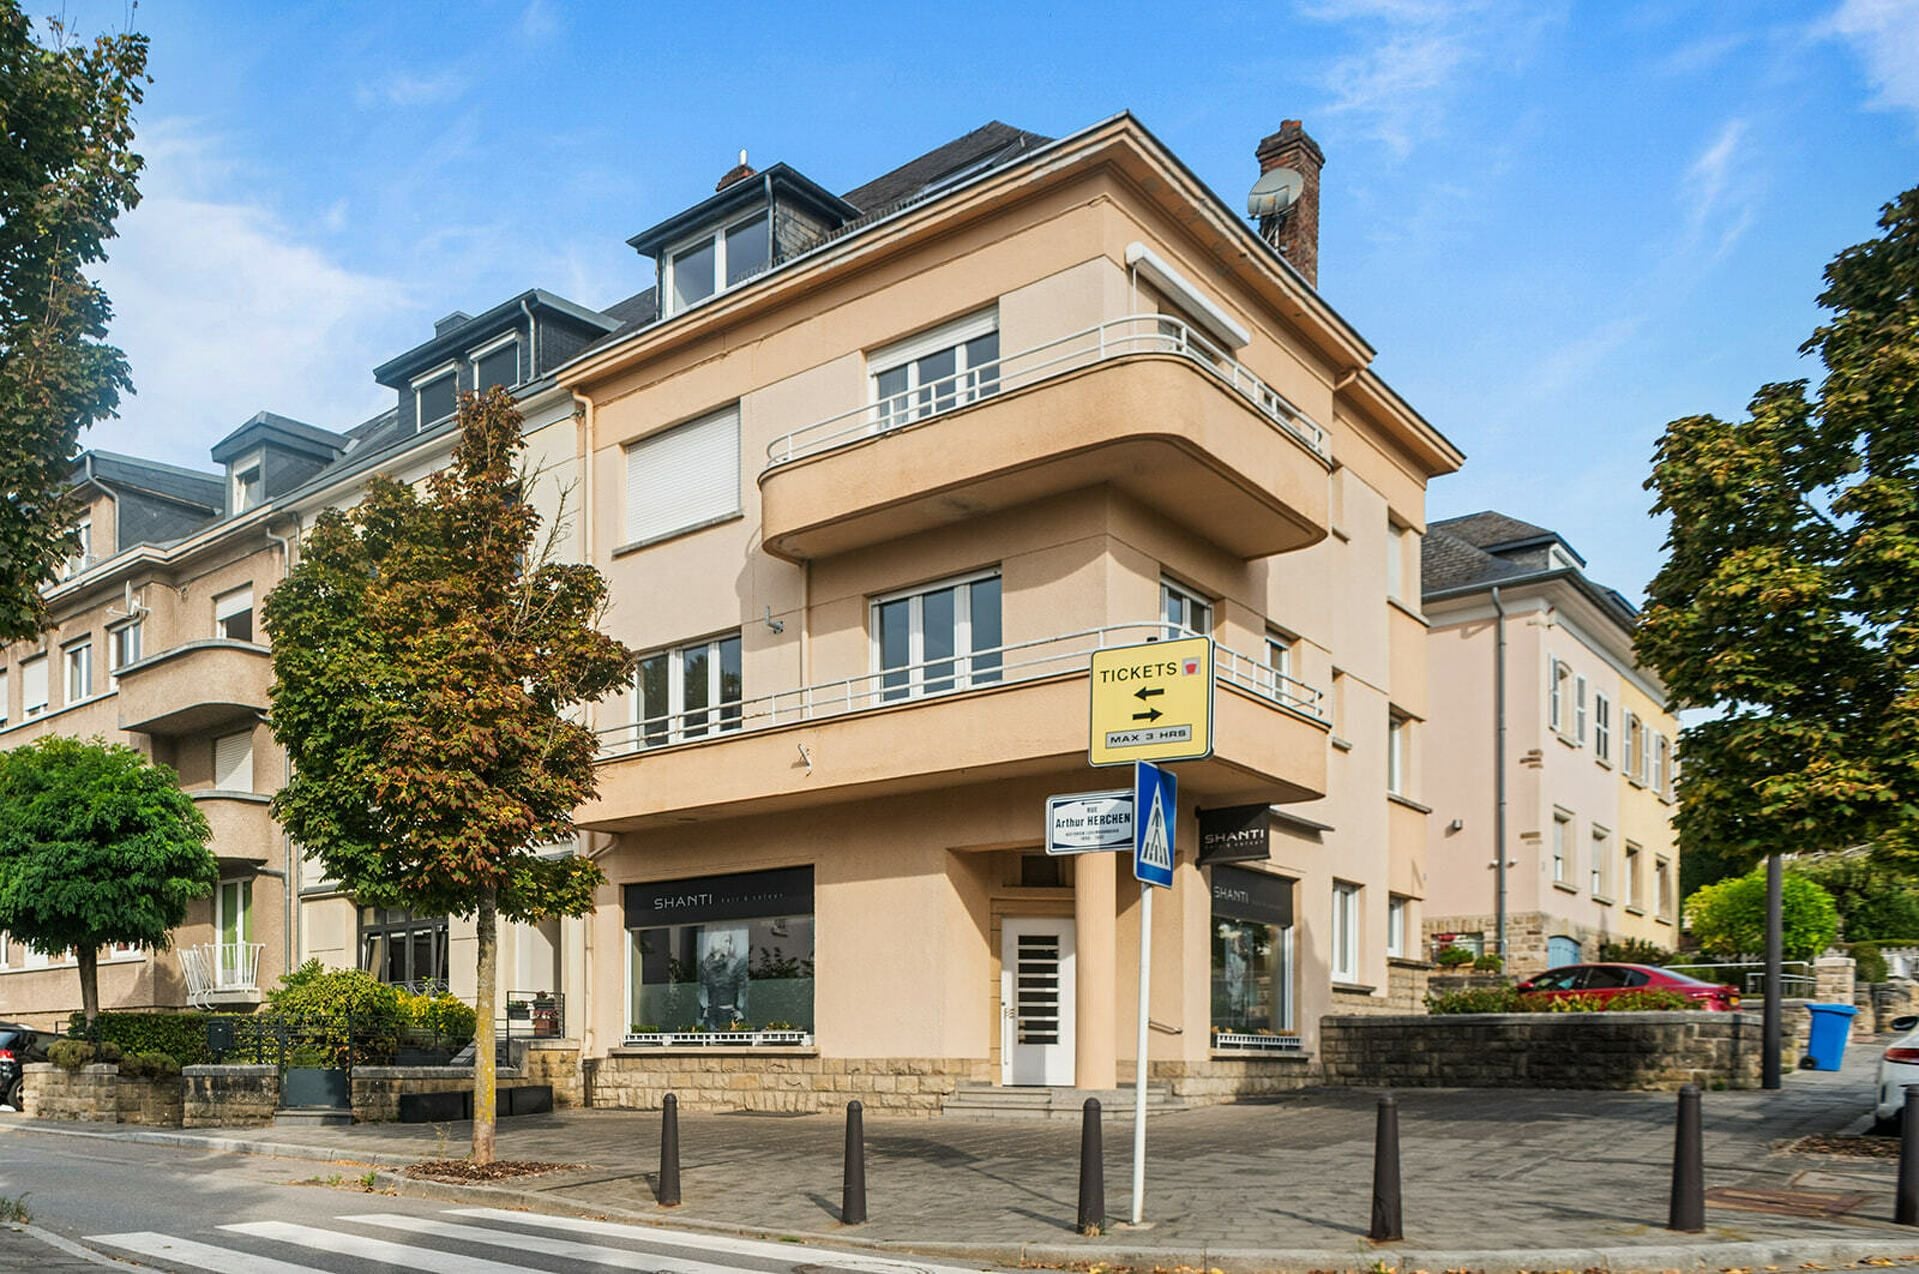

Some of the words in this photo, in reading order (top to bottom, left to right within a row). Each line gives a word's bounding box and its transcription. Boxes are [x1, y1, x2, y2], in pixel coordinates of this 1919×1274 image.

[1100, 662, 1177, 683] TICKETS
[1110, 734, 1139, 744] MAX
[1159, 729, 1186, 738] HRS
[1055, 818, 1085, 828] Arthur
[1087, 813, 1131, 826] HERCHEN
[1204, 829, 1265, 844] SHANTI
[654, 893, 713, 909] SHANTI
[1213, 886, 1249, 904] SHANTI
